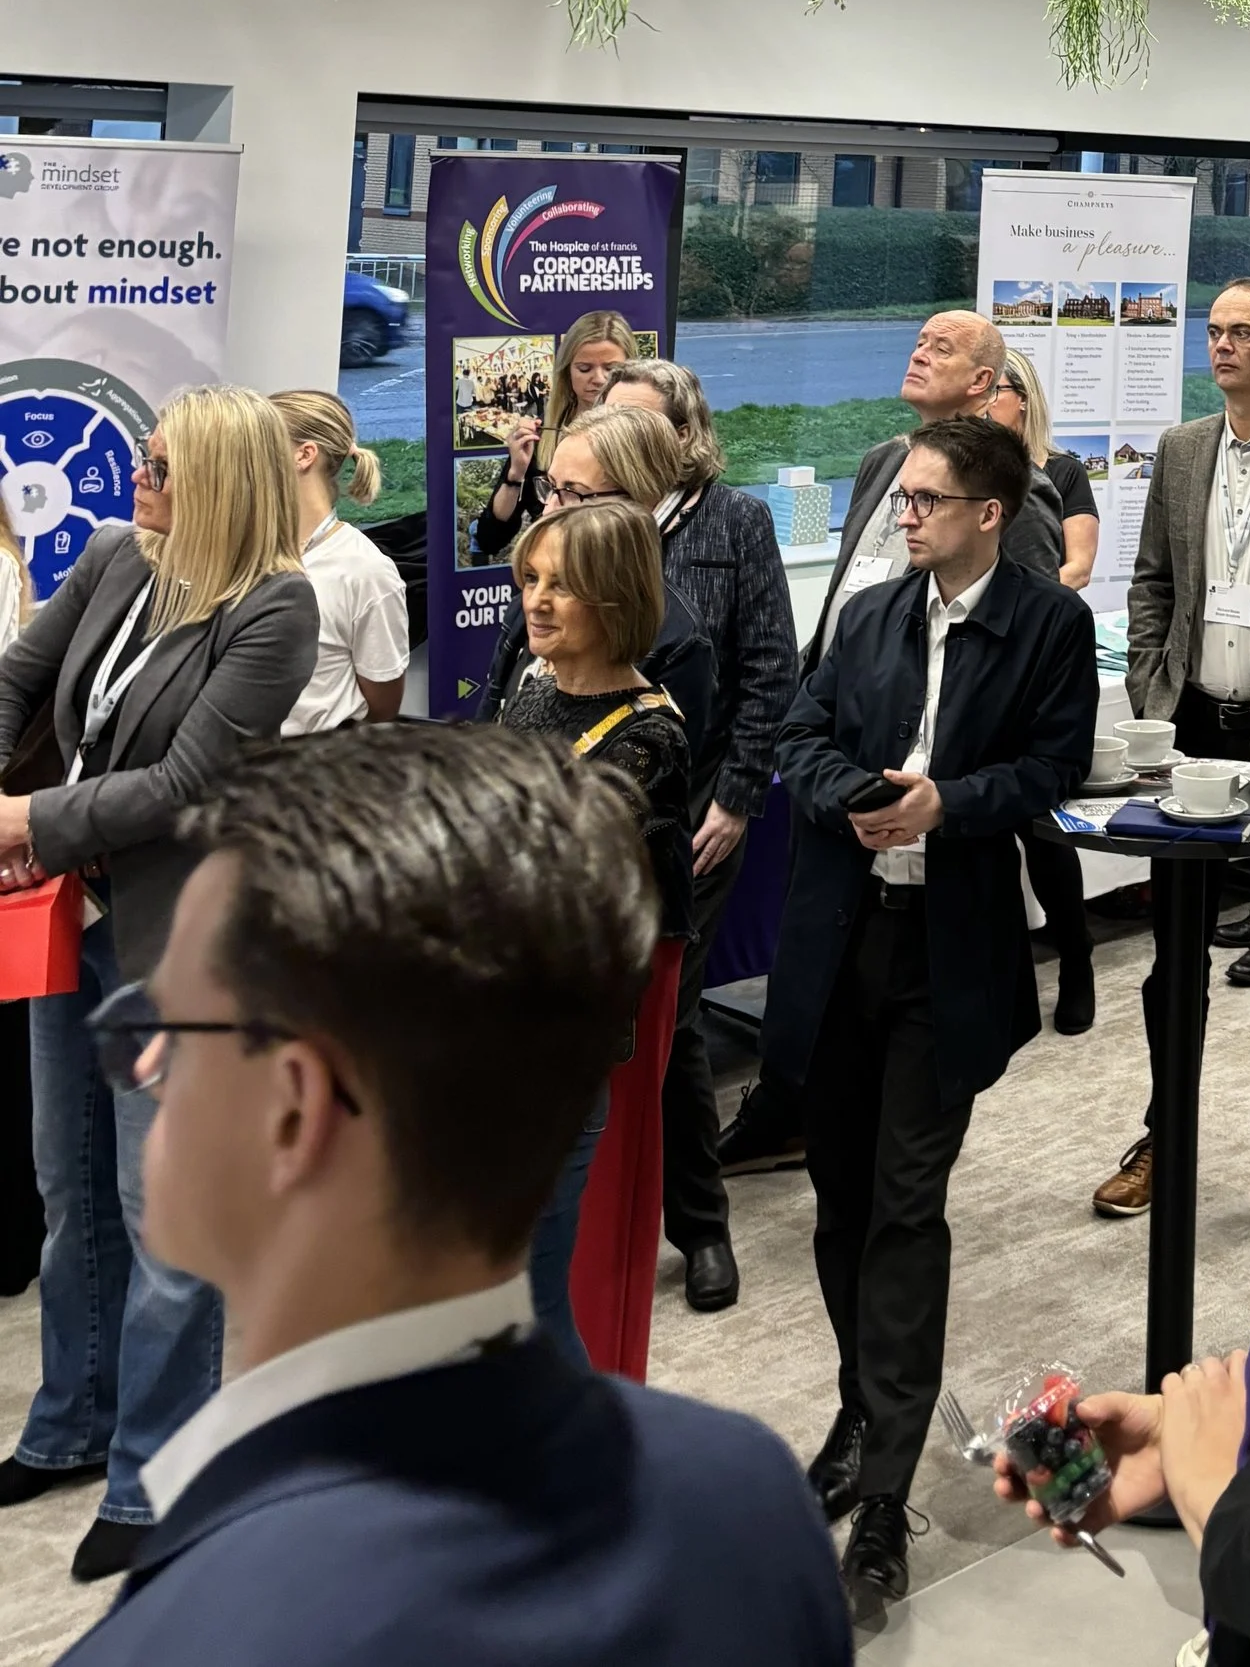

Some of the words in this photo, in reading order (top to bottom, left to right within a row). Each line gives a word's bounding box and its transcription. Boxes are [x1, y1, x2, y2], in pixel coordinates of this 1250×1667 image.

[41, 164, 122, 184] mindset
[94, 184, 120, 192] GROUP
[505, 191, 554, 233] Volunteering
[541, 202, 601, 222] Collaborating
[481, 203, 509, 256] Sponsoring
[1010, 224, 1042, 238] Make
[1045, 225, 1096, 239] business
[31, 234, 89, 258] not
[98, 231, 222, 267] enough.
[460, 226, 477, 288] Networking
[529, 241, 547, 252] The
[550, 241, 589, 253] Hospice
[611, 241, 637, 252] francis
[1062, 242, 1078, 253] a
[533, 256, 642, 274] CORPORATE
[88, 276, 217, 304] mindset
[520, 273, 654, 292] PARTNERSHIPS
[24, 412, 55, 421] Focus
[105, 449, 121, 497] Resilience
[461, 584, 513, 608] YOUR
[455, 606, 495, 628] OUR
